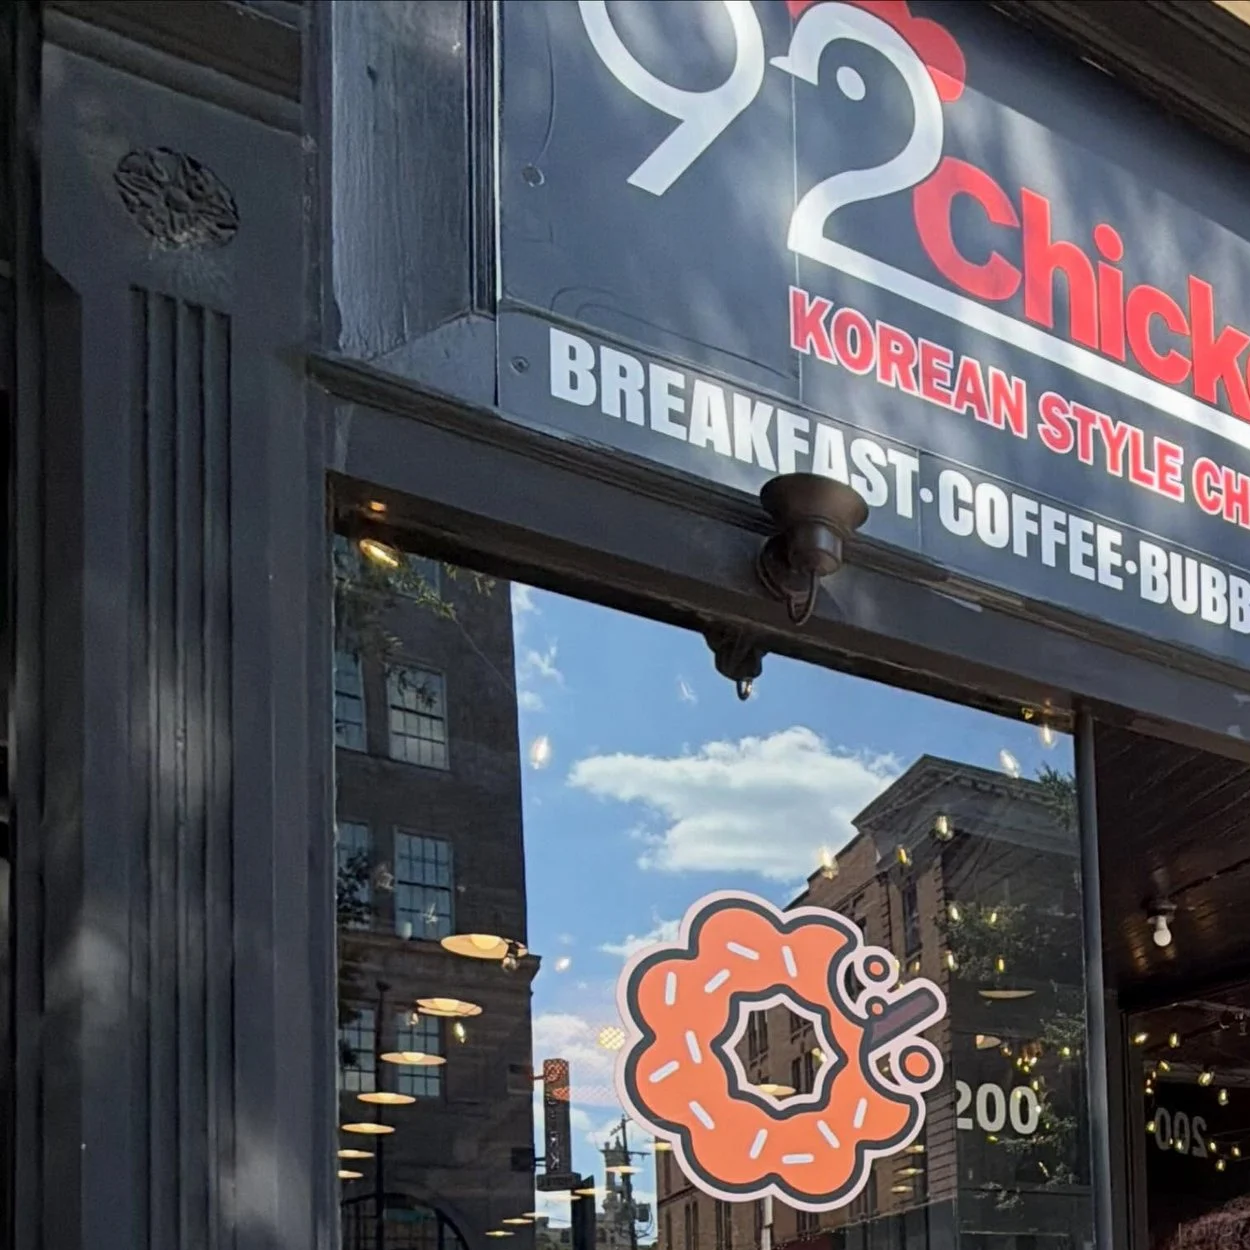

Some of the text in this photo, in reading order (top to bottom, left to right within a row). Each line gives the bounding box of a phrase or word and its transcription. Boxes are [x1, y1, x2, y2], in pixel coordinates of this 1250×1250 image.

[577, 0, 944, 254] 92
[788, 285, 1028, 438] KOREAN
[1037, 391, 1186, 503] STYLE
[955, 1080, 1040, 1136] 200
